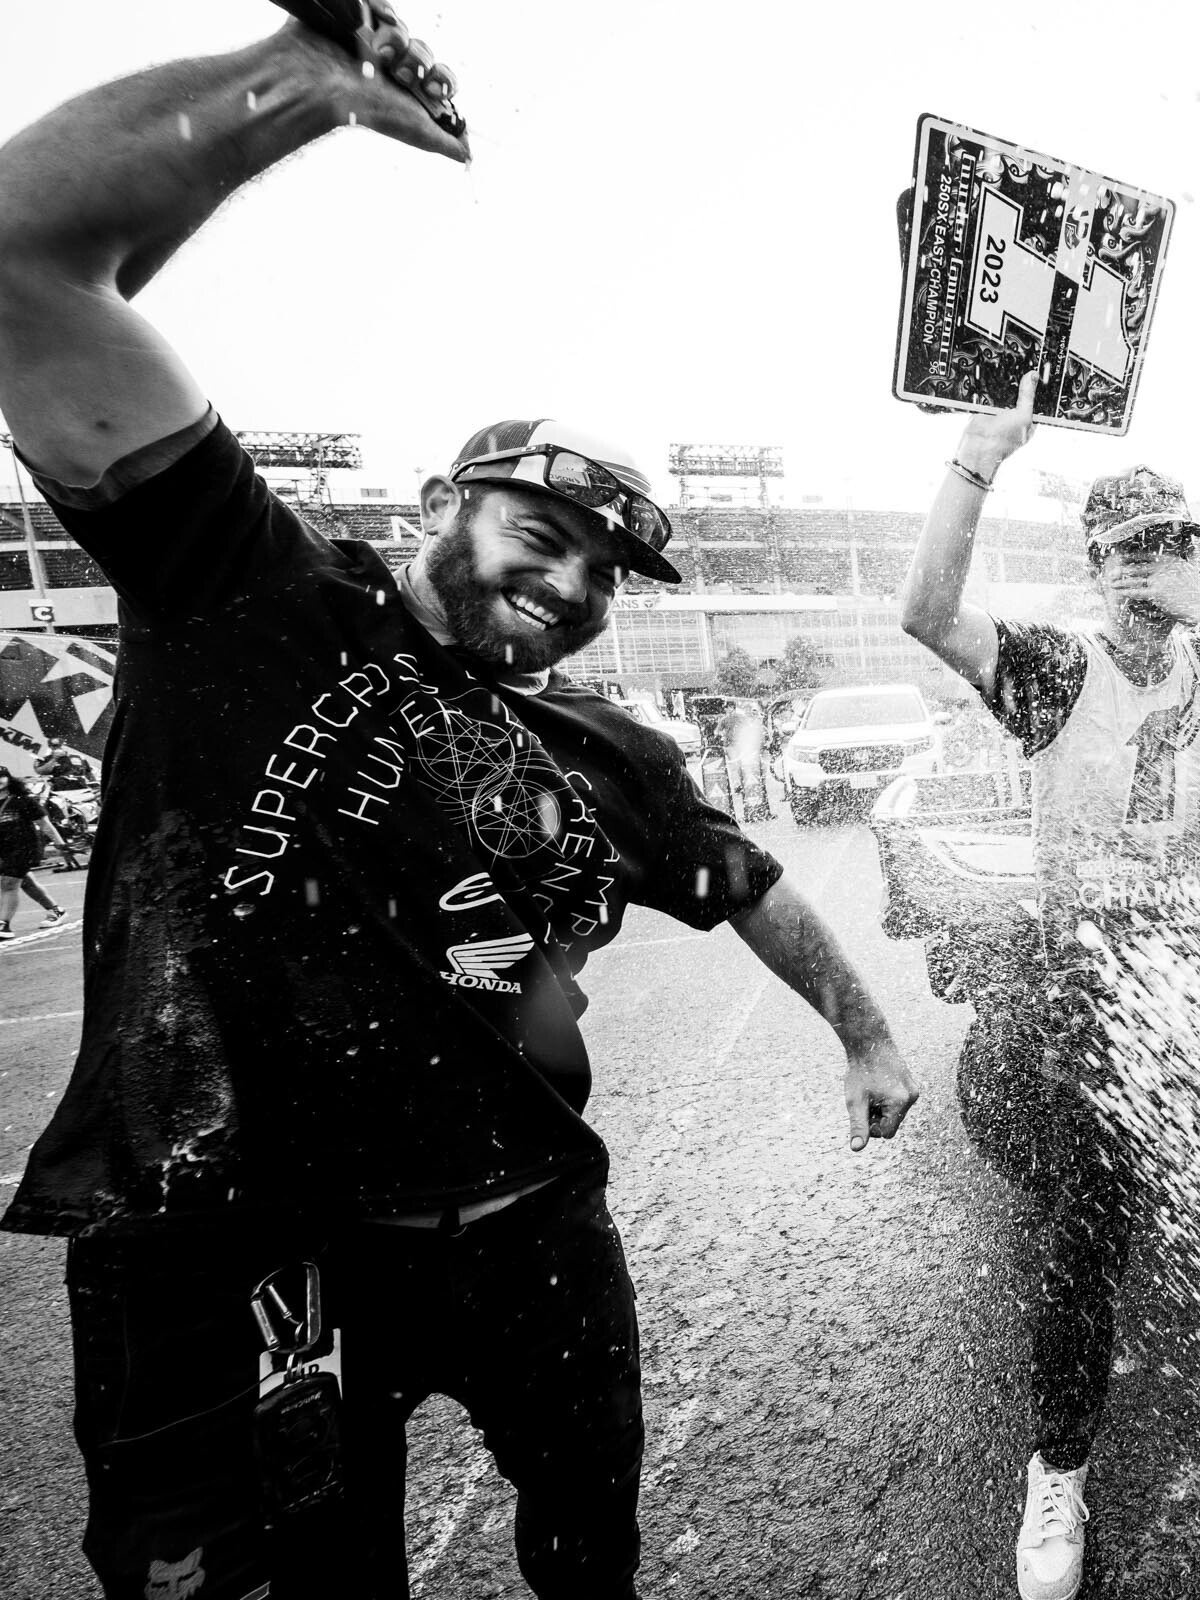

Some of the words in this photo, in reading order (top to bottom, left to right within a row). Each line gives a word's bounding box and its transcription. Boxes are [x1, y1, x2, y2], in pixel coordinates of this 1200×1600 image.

[931, 223, 949, 266] EAST
[979, 234, 1006, 304] 2023
[922, 267, 942, 344] CHAMPION
[33, 606, 53, 621] C
[439, 970, 523, 994] HONDA
